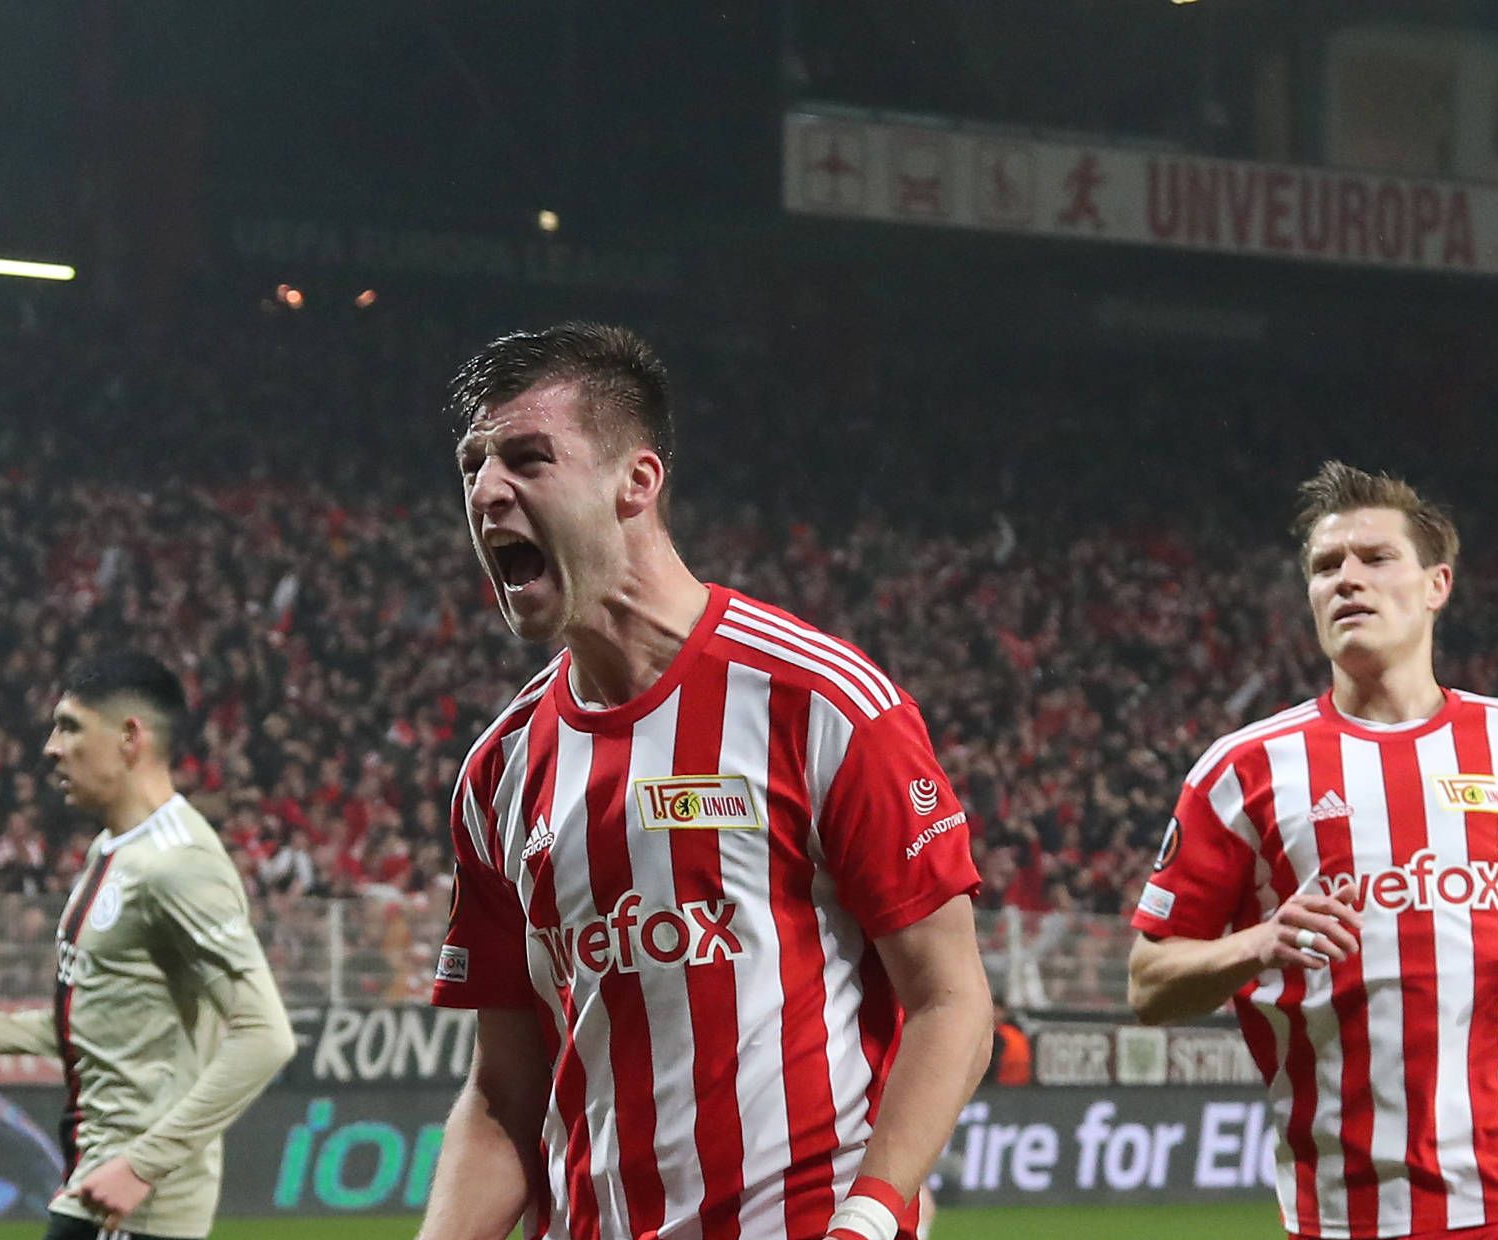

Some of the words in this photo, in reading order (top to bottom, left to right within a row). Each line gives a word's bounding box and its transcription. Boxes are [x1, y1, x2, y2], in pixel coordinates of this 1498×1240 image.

[702, 796, 747, 817] UNION
[531, 891, 745, 987] wefox
[1076, 1101, 1185, 1191] for
